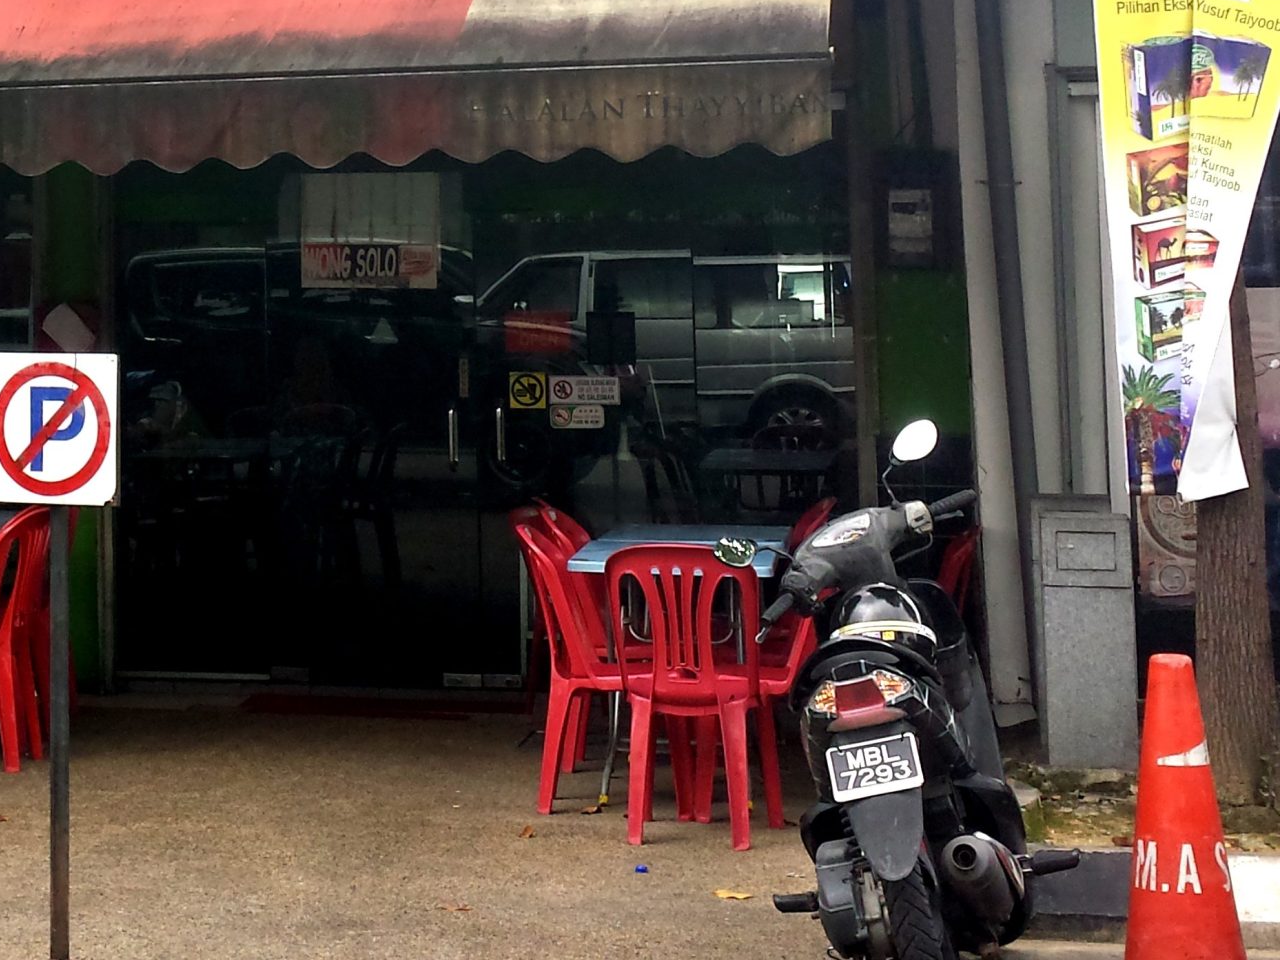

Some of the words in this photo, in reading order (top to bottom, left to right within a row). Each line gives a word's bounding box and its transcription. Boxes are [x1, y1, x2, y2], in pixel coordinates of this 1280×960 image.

[1117, 0, 1159, 15] Pilihan
[1191, 132, 1232, 150] matilah
[1201, 157, 1235, 178] Kurma
[1202, 170, 1241, 192] Taiyoob
[1190, 195, 1209, 208] dan
[305, 247, 351, 279] WONG
[356, 248, 396, 277] SOLO
[30, 386, 86, 472] P
[846, 744, 901, 770] MBL
[840, 759, 912, 790] 7293
